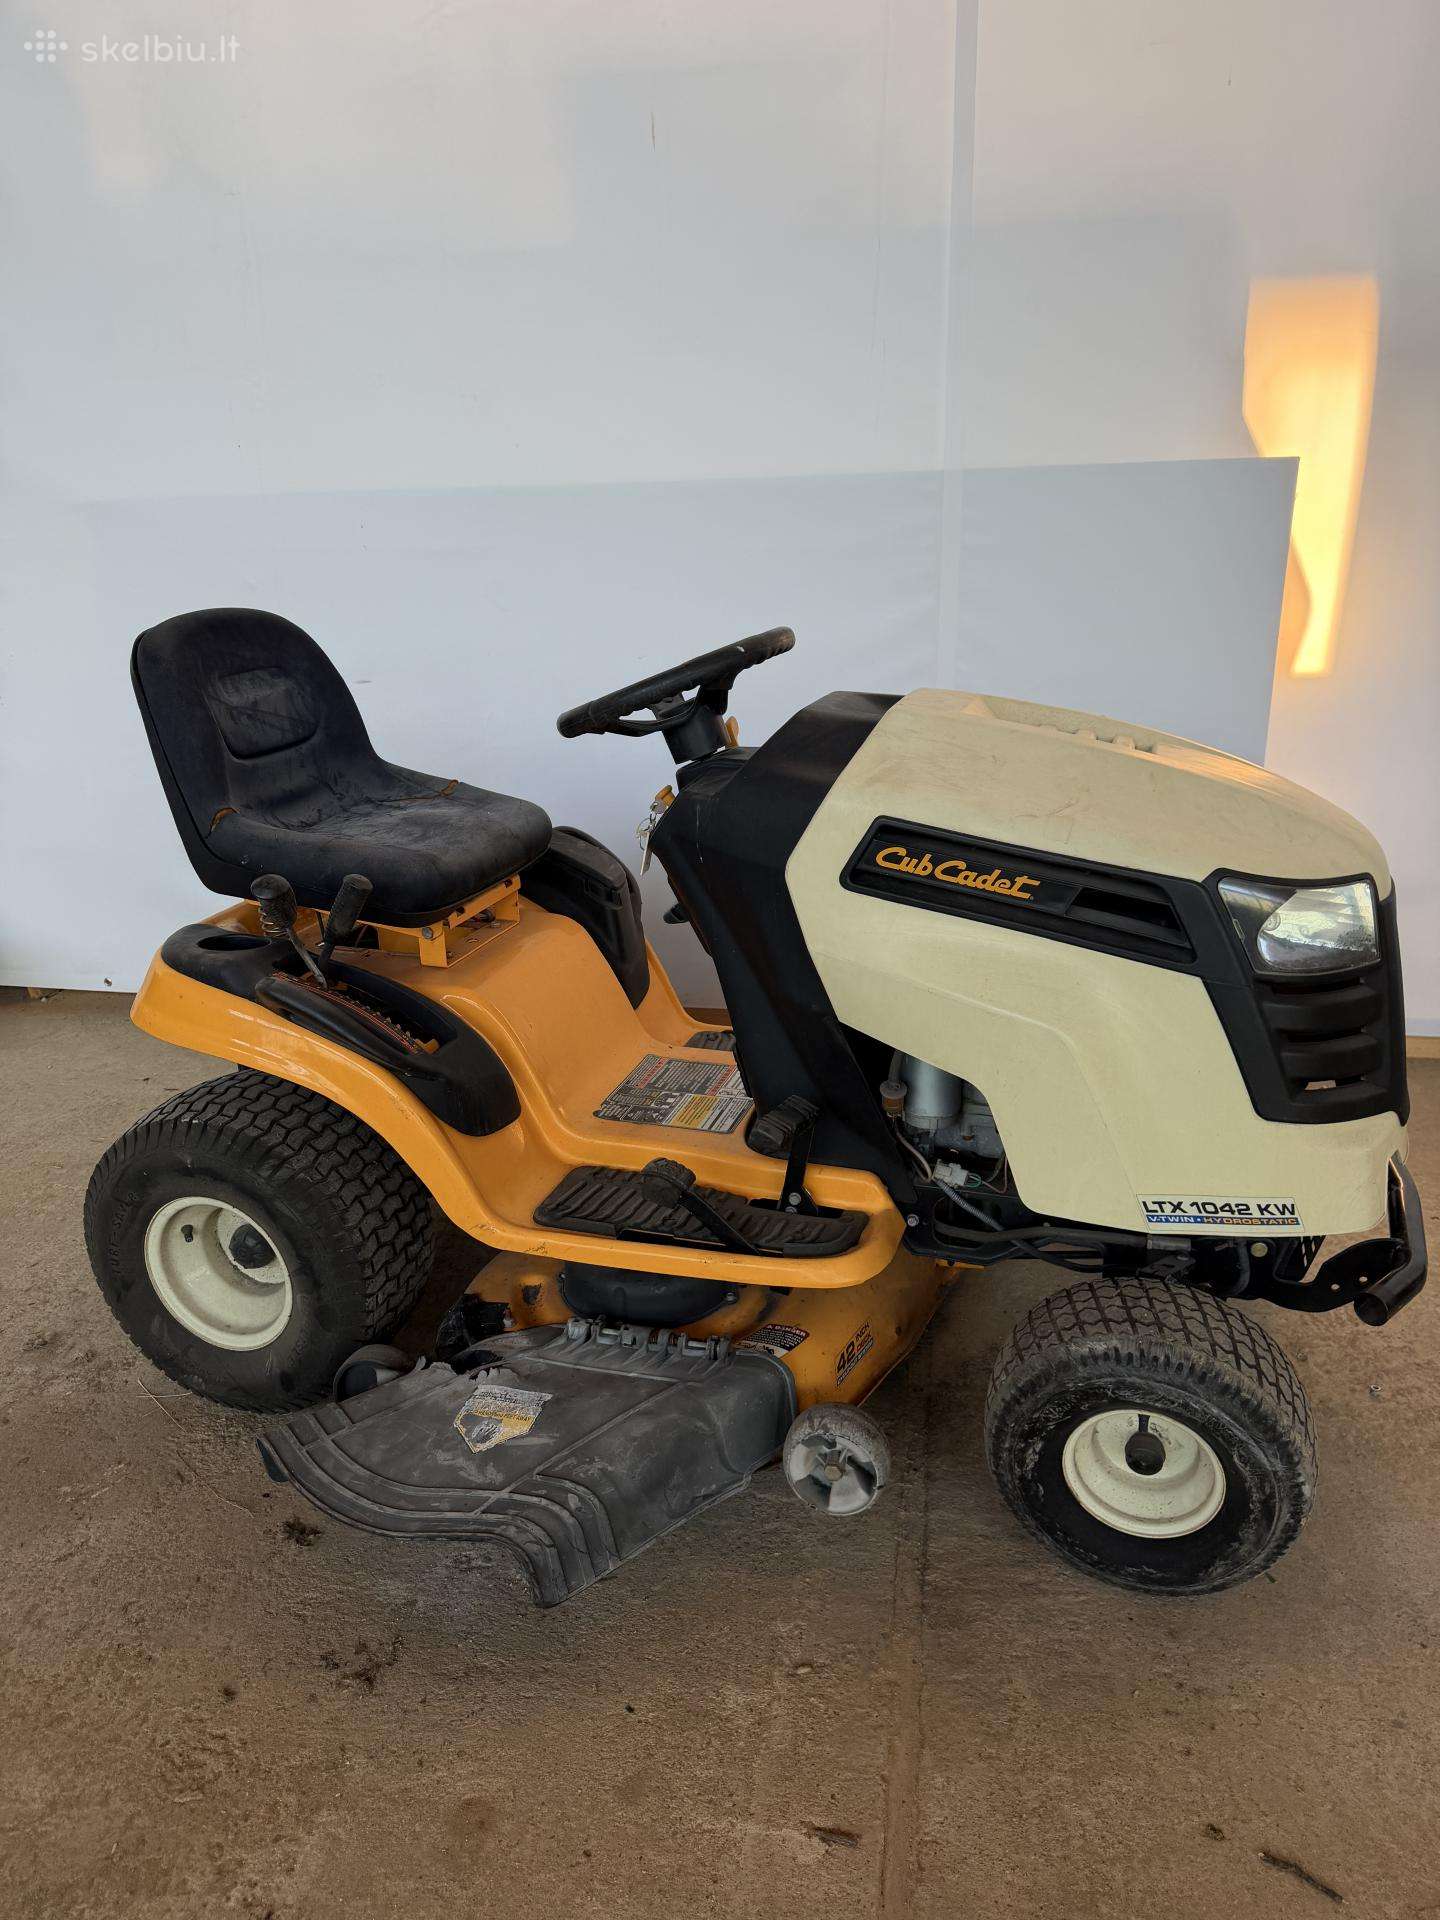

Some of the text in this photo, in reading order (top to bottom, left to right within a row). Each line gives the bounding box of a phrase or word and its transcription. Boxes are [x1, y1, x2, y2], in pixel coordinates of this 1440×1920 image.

[875, 846, 1041, 899] Cub Cadet
[1142, 1200, 1296, 1216] LTX 1042 KW
[1204, 1217, 1297, 1225] HYDROSTATIC
[836, 1341, 856, 1374] 42
